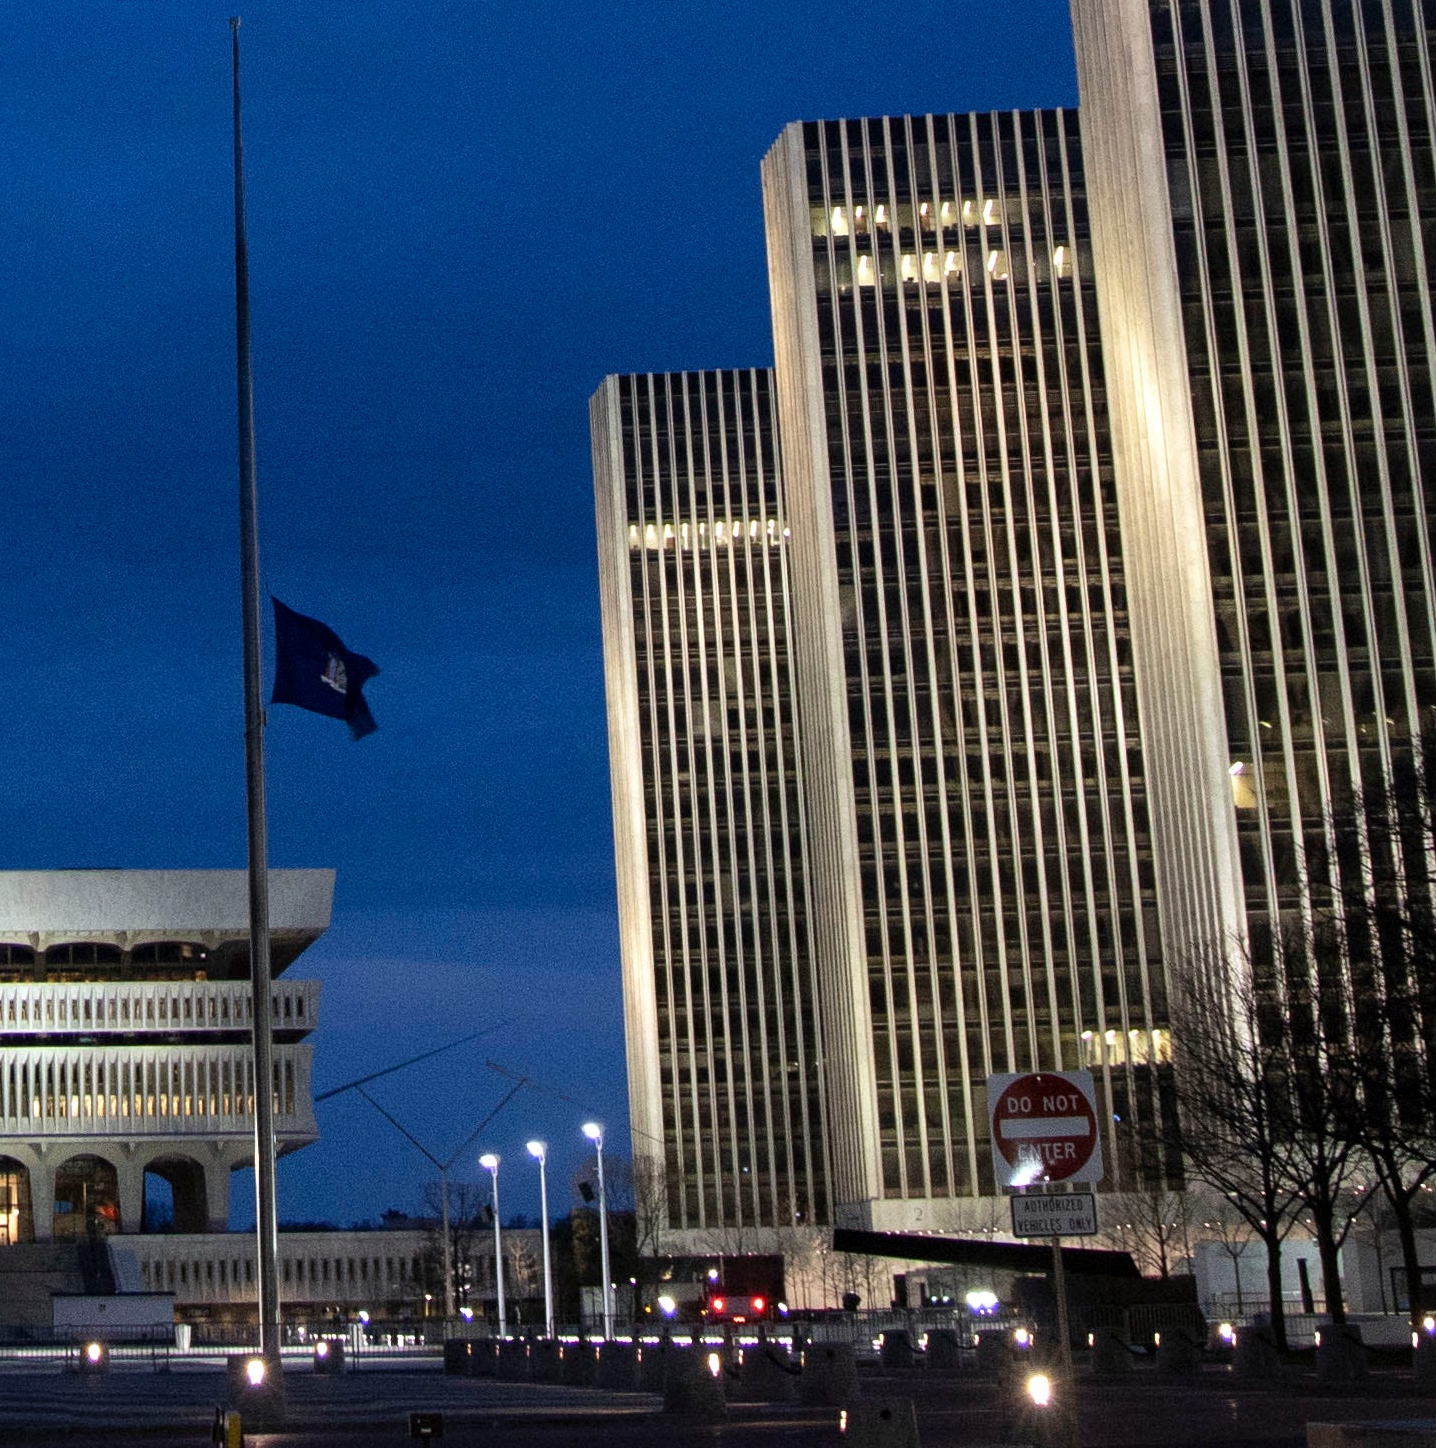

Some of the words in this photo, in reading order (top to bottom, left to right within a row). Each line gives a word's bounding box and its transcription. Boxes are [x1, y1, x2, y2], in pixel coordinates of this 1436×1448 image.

[1006, 1096, 1030, 1113] DO
[1042, 1094, 1079, 1112] NOT
[1017, 1141, 1077, 1161] ENTER
[1023, 1198, 1084, 1213] AUTHORIZED
[1017, 1218, 1062, 1233] VEHICLES
[1068, 1216, 1093, 1231] ONLY
